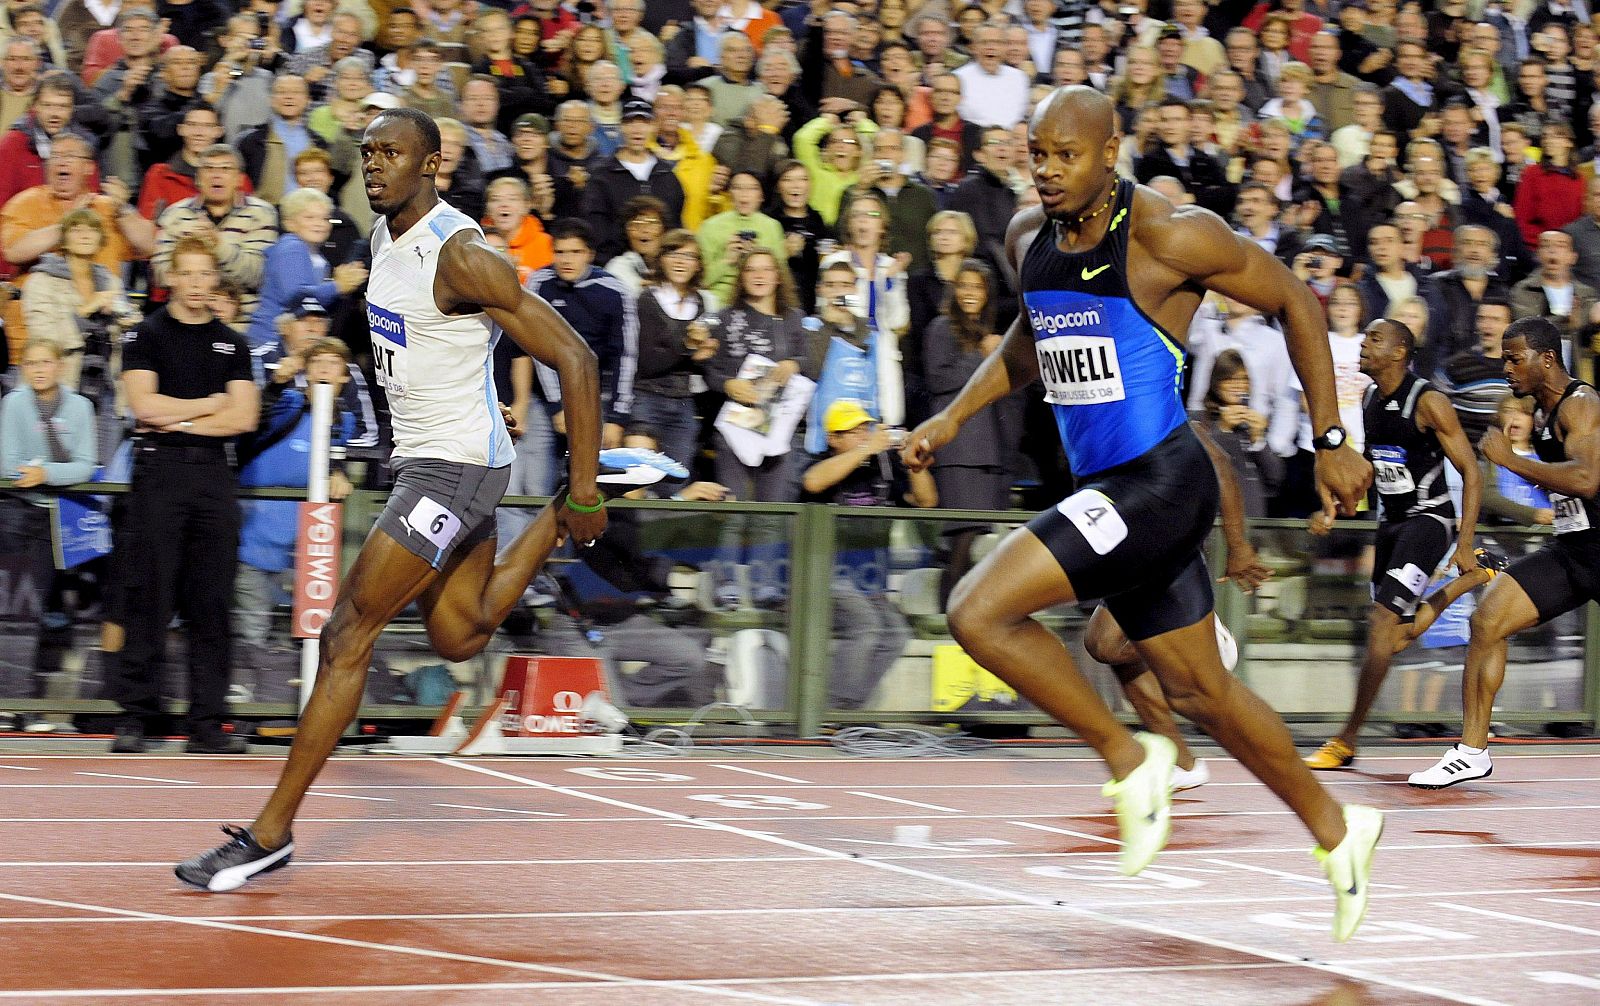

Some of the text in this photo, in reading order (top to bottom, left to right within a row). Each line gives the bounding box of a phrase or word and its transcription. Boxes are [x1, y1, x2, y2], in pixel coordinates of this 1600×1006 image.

[367, 306, 401, 334] lgacom
[1039, 346, 1114, 384] POWELL
[430, 513, 449, 534] 6
[1083, 507, 1108, 527] 4
[305, 505, 336, 600] OMEGA
[686, 794, 832, 810] 8
